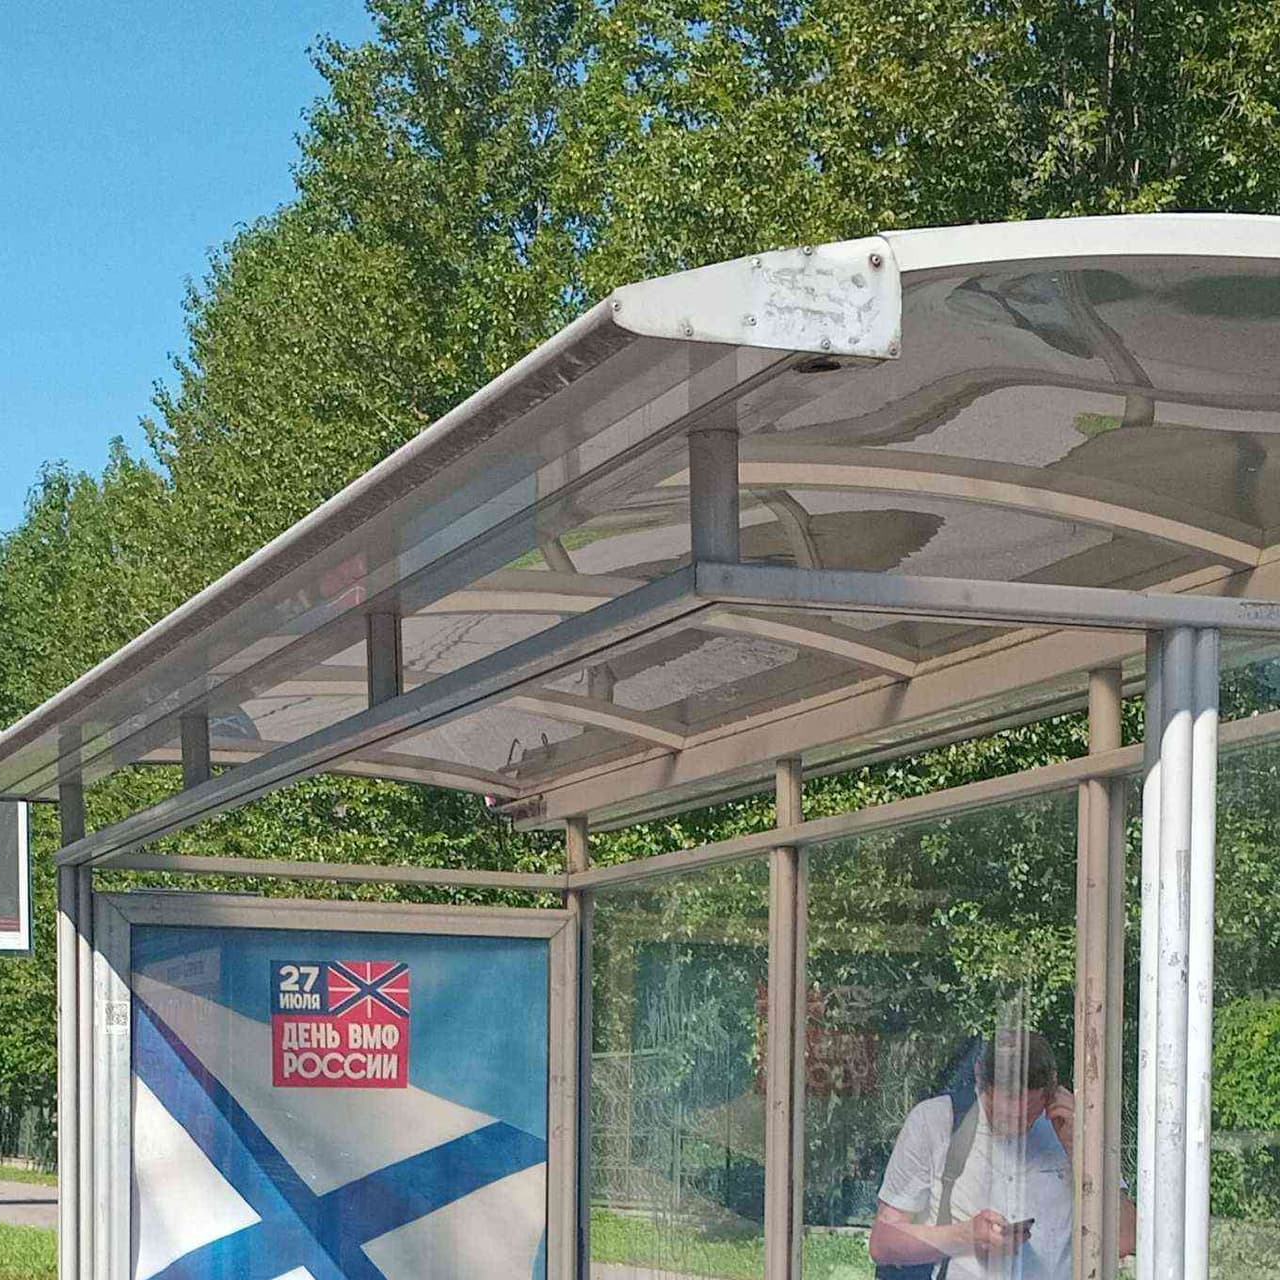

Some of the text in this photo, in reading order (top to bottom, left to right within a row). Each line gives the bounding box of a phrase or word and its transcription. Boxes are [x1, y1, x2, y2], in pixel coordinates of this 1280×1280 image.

[279, 965, 320, 992] 27
[279, 993, 321, 1009] ИЮЛЯ
[282, 1021, 400, 1050] ДЕНЬ ВМФ
[283, 1052, 398, 1080] РОССИИ
